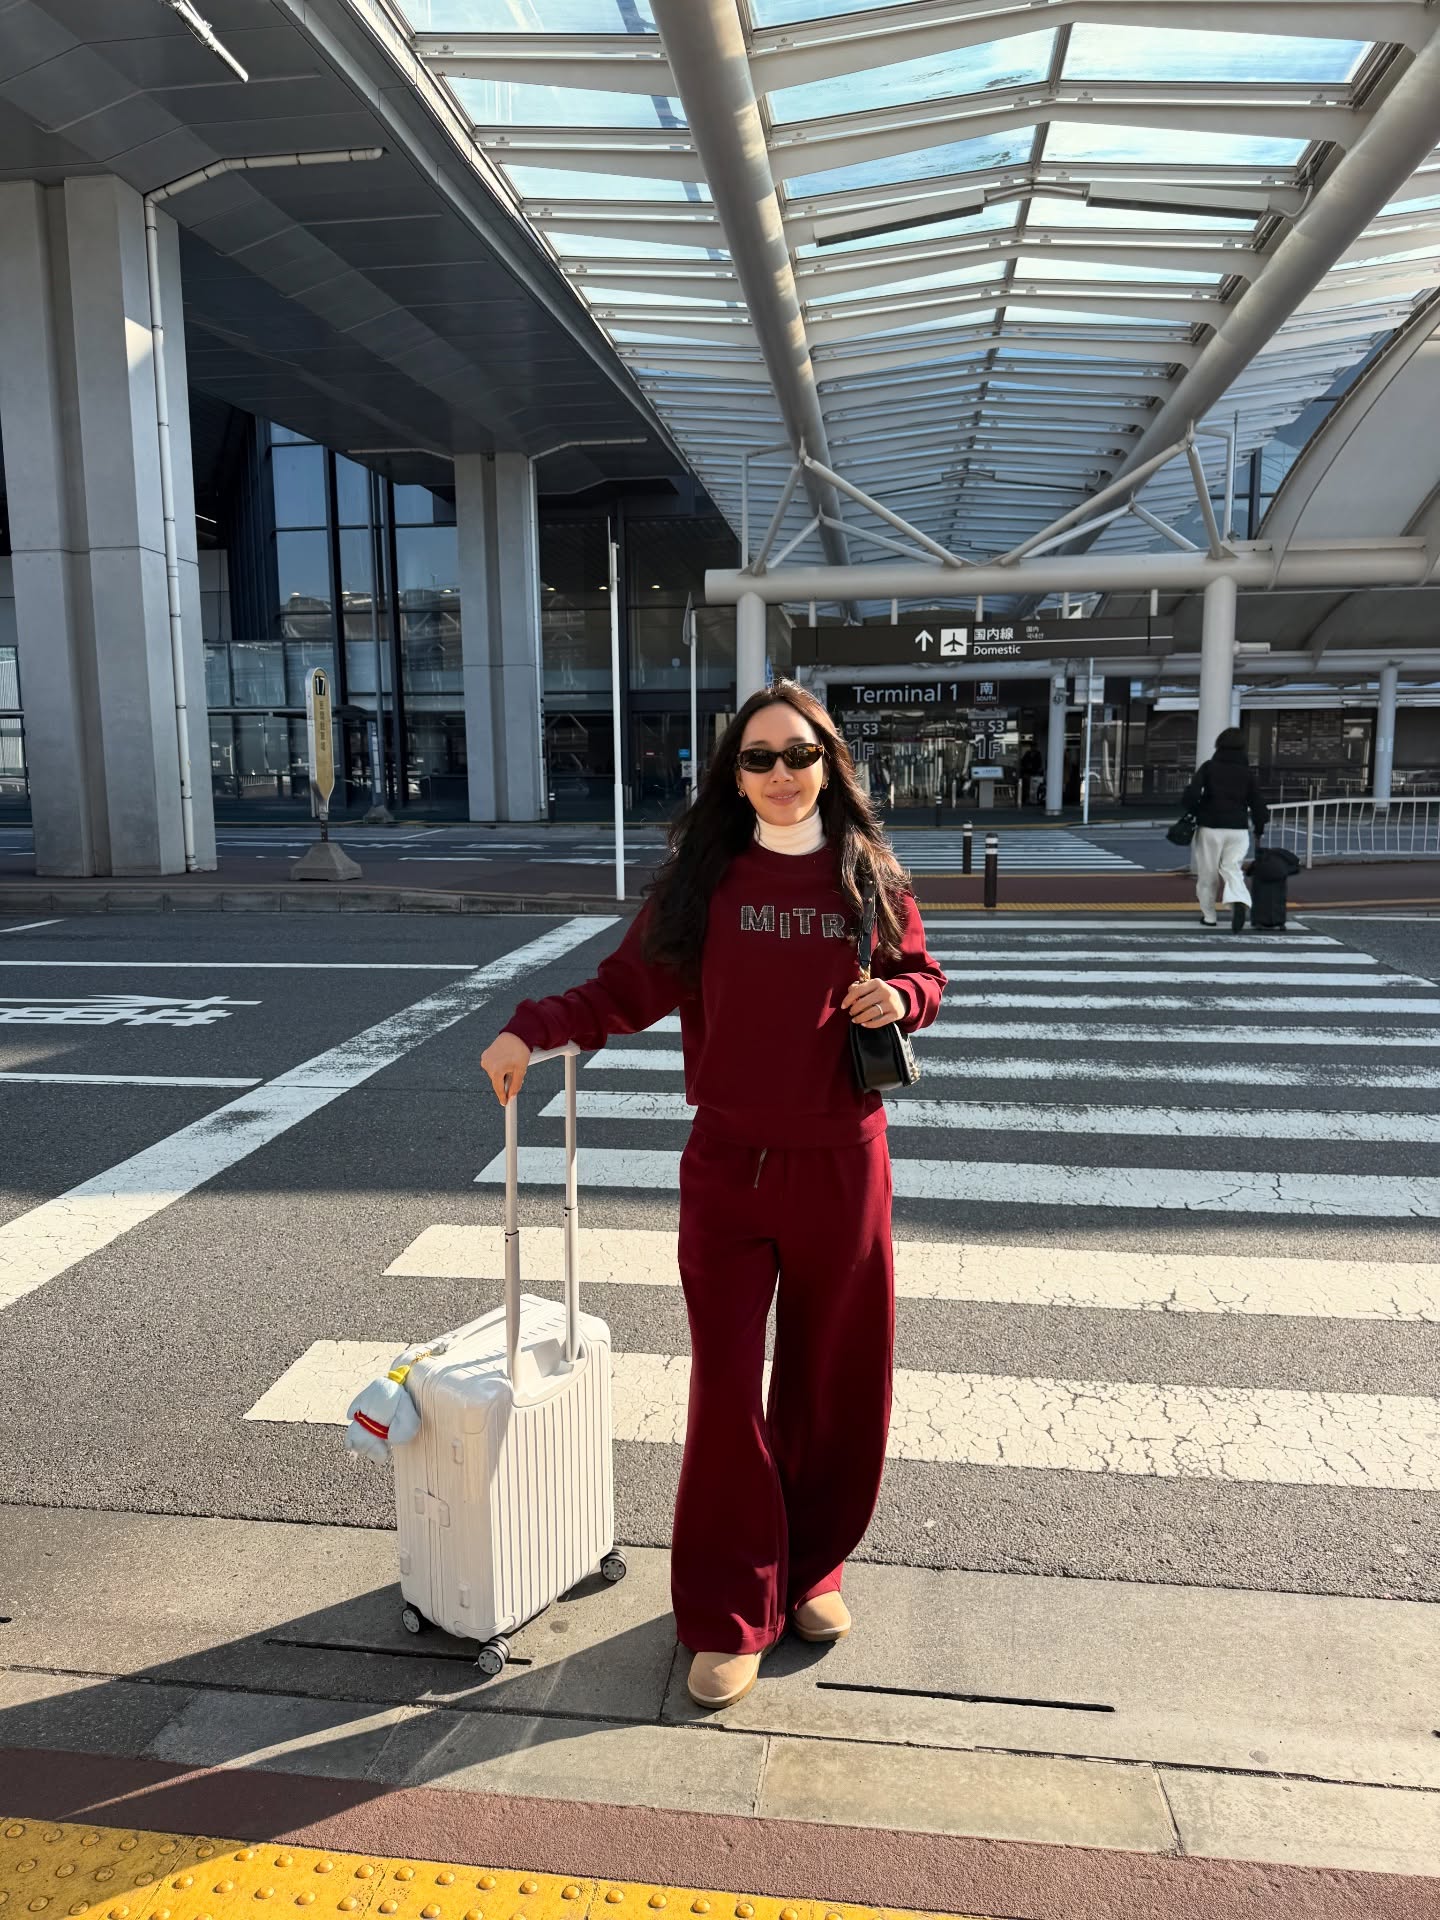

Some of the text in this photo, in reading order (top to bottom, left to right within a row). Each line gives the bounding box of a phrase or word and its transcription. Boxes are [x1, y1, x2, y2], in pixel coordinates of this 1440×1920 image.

[973, 627, 1014, 641] 国内線
[973, 645, 1021, 656] Domestic
[315, 676, 325, 695] 17
[852, 682, 958, 704] Terminal 1
[979, 682, 994, 695] 南
[862, 723, 879, 736] S3
[988, 720, 1005, 733] S3
[849, 738, 875, 762] 1F
[975, 736, 1001, 760] 1F
[740, 905, 846, 938] MITR
